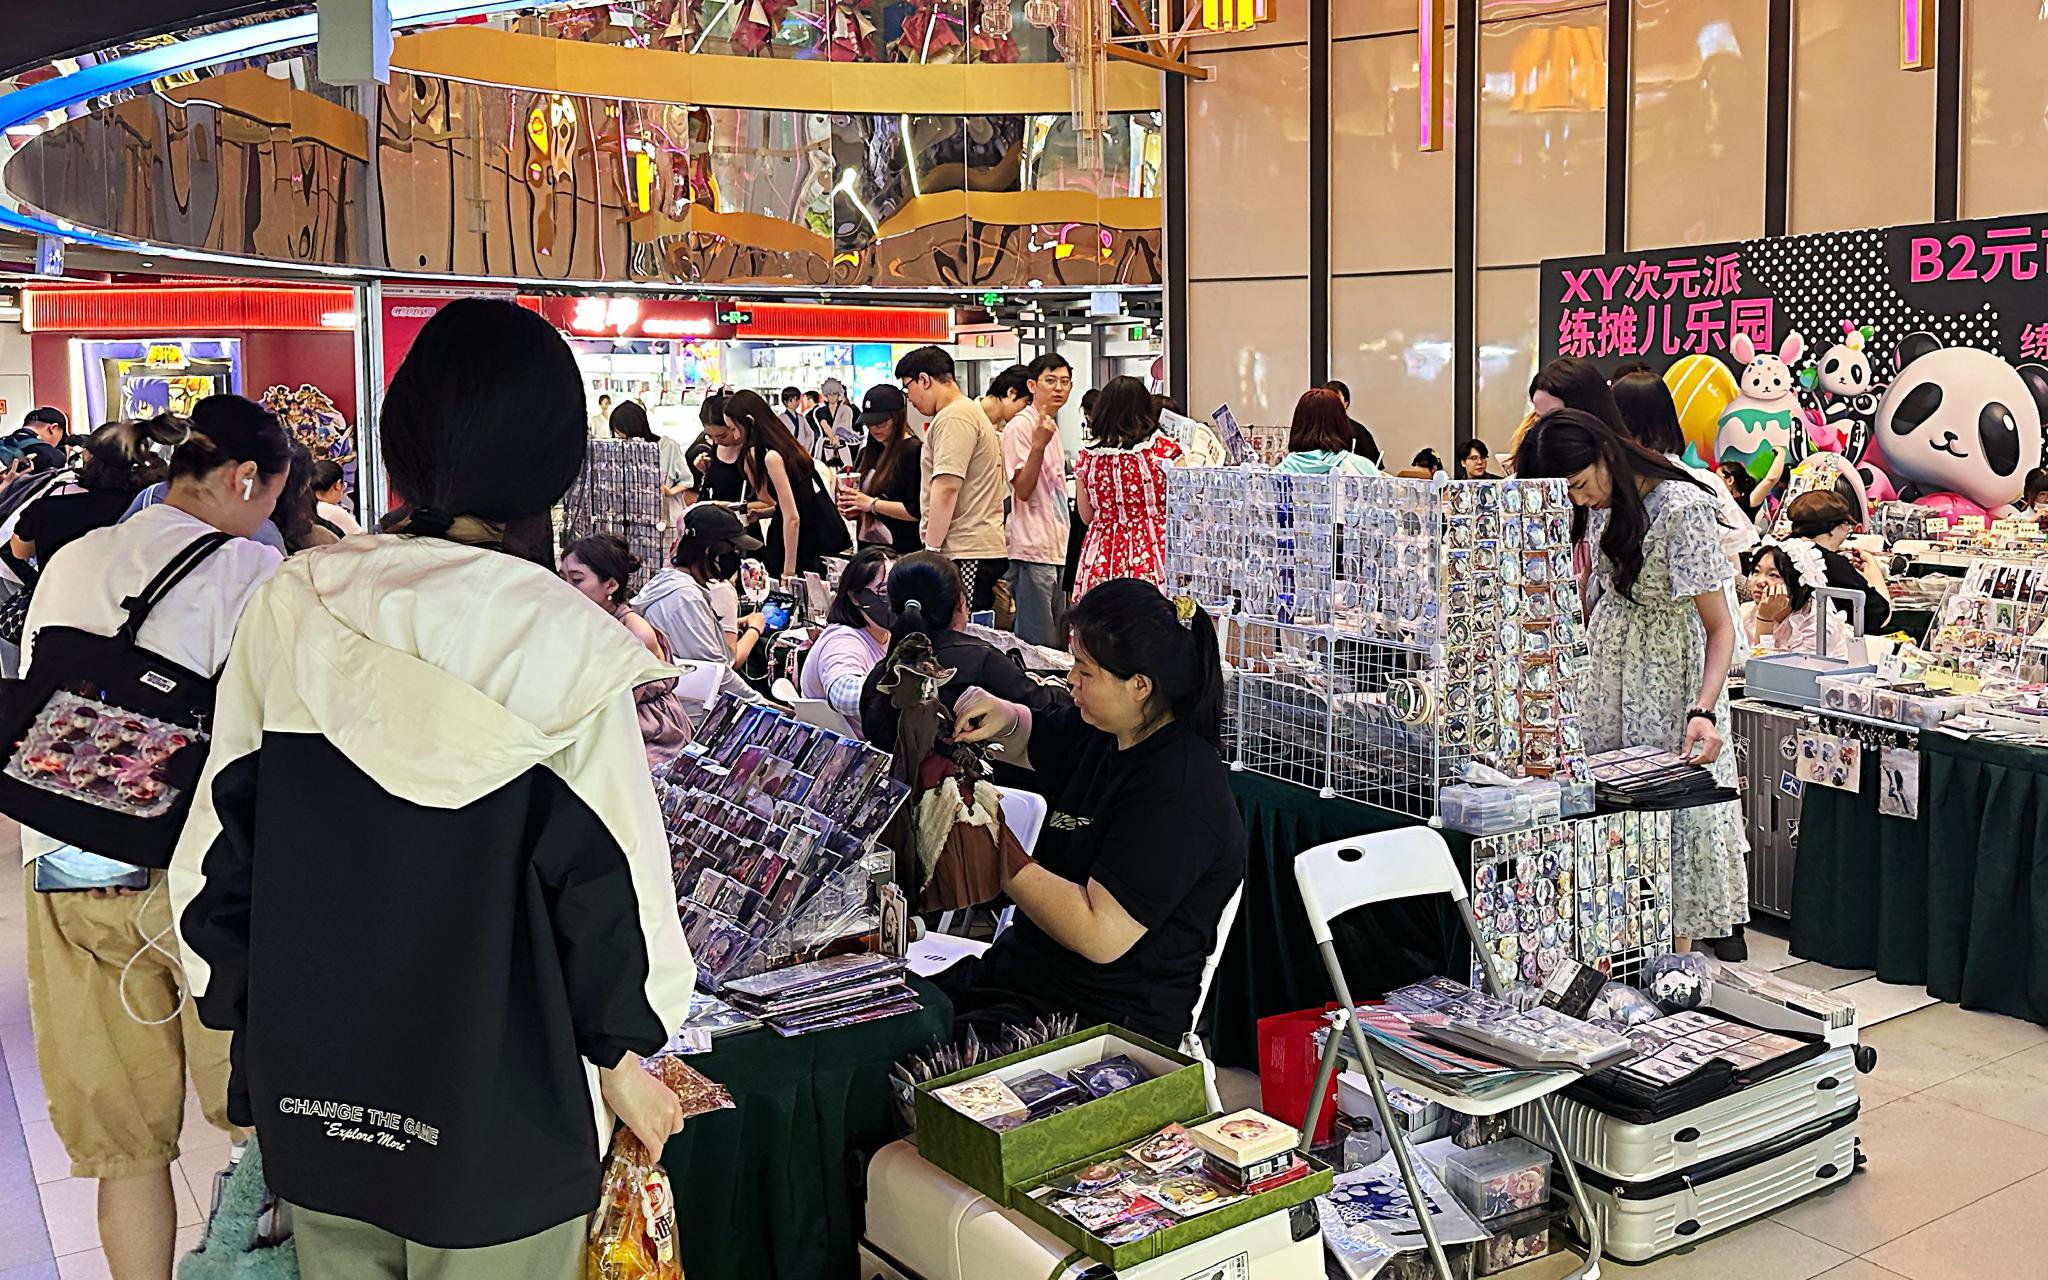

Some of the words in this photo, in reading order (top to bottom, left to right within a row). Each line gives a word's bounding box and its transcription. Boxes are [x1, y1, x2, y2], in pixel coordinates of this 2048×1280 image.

[1560, 252, 1743, 303] XY次元派
[1557, 297, 1775, 358] 练摊儿乐园
[279, 1097, 364, 1123] CHANGE
[367, 1108, 402, 1130] THE
[403, 1118, 439, 1146] GAME
